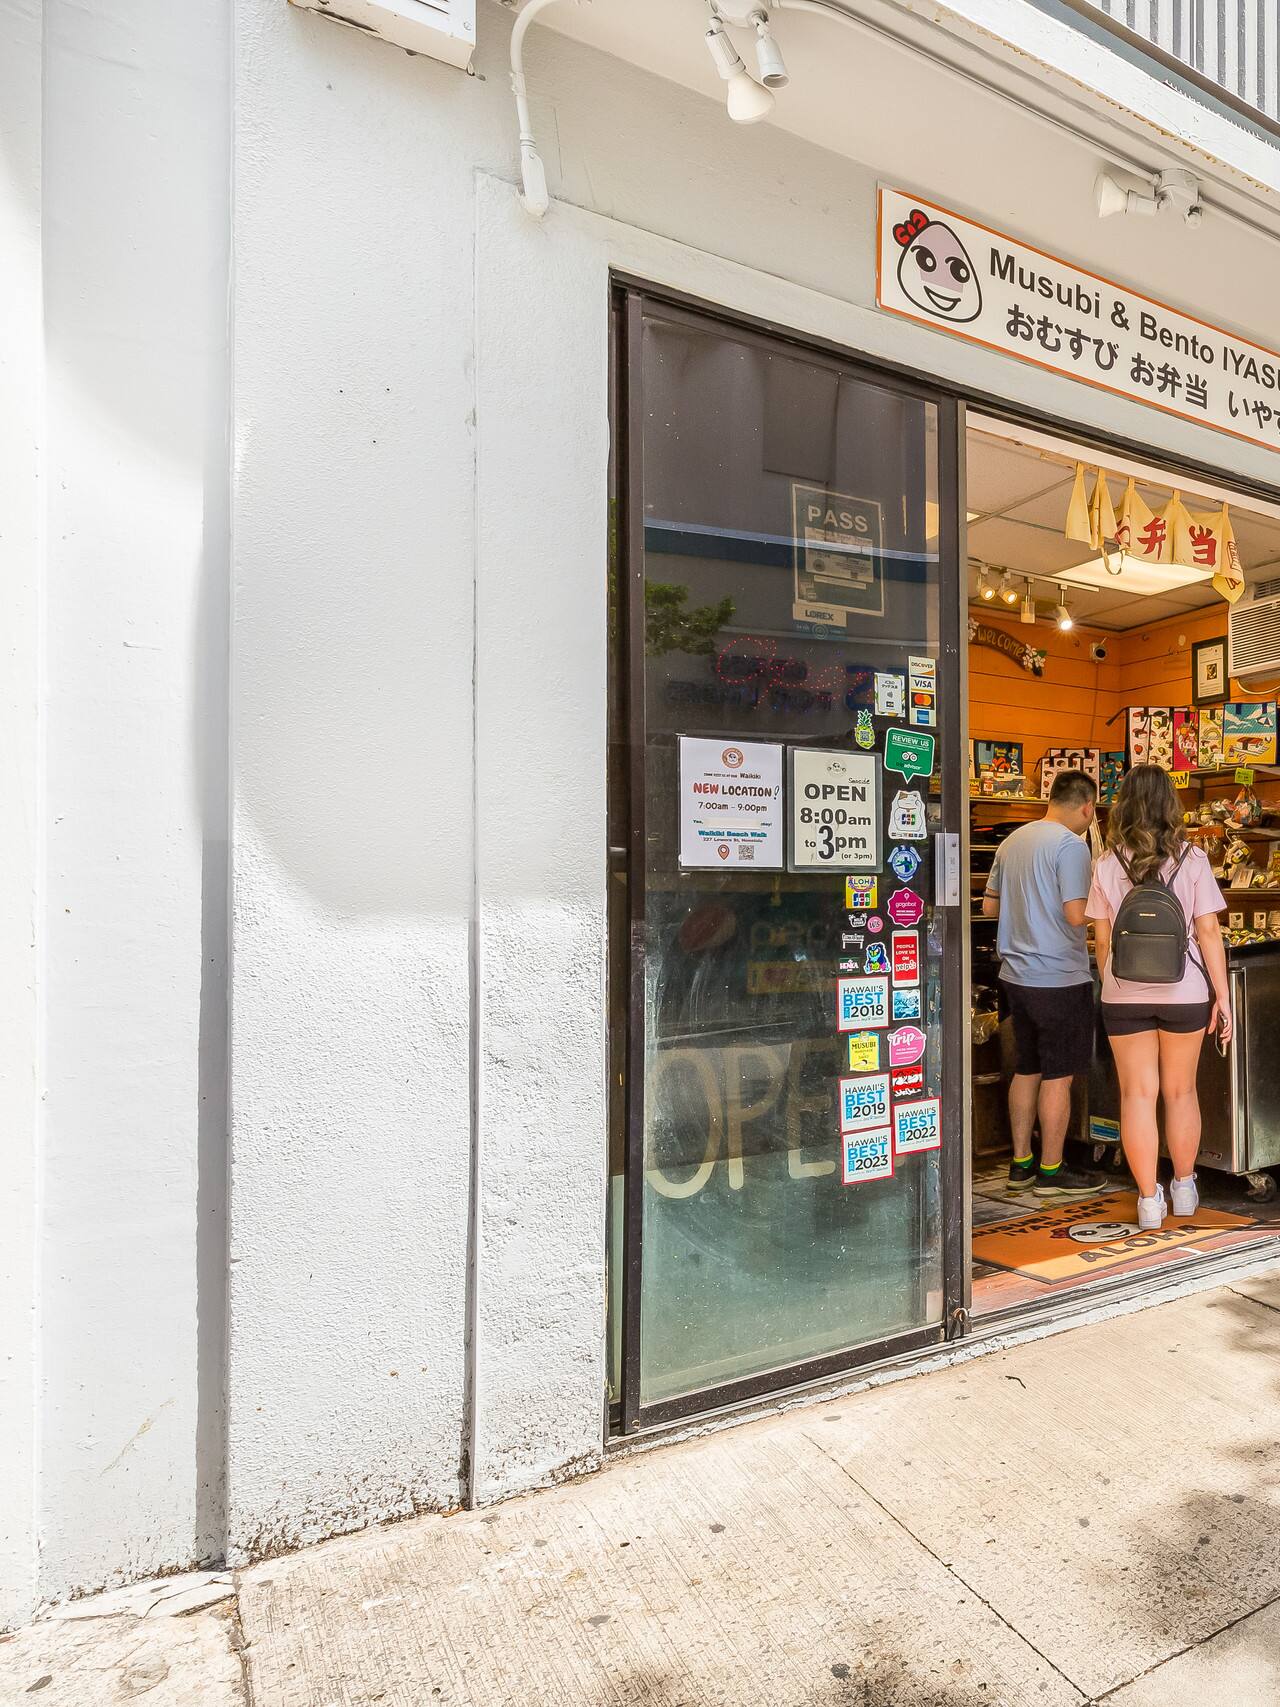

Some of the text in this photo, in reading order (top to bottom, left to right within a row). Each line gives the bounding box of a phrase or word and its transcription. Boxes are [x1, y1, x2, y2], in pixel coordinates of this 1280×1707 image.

[990, 247, 1100, 319] Musubi
[1110, 300, 1131, 331] &
[1140, 311, 1215, 364] Bento
[1006, 303, 1119, 372] おむすび
[1130, 352, 1208, 410] お弁当
[808, 504, 868, 533] PASS
[914, 680, 932, 688] VISA
[892, 735, 918, 745] REVIEW
[740, 772, 761, 780] Waikiki
[693, 782, 719, 795] NEW
[804, 783, 866, 802] OPEN
[698, 802, 729, 810] 7:00am
[737, 803, 768, 814] 9:00pm
[804, 839, 817, 848] to
[852, 894, 871, 905] JCB
[896, 963, 910, 972] yelp
[843, 985, 884, 994] HAWAII'S
[843, 992, 884, 1007] BEST
[851, 1004, 884, 1018] 2018
[851, 1041, 876, 1050] MUSUBI
[845, 1083, 885, 1095] HAWAII'S
[845, 1090, 885, 1107] BEST
[853, 1102, 886, 1119] 2019
[898, 1107, 937, 1119] HAWAII'S
[898, 1113, 937, 1131] BEST
[906, 1125, 937, 1141] 2022
[847, 1135, 888, 1148] HAWAII'S
[847, 1142, 888, 1160] BEST
[855, 1154, 889, 1170] 2023
[1064, 1198, 1121, 1214] CAFE
[1002, 1208, 1116, 1237] IYASUME
[1078, 1222, 1200, 1264] ALOHA
